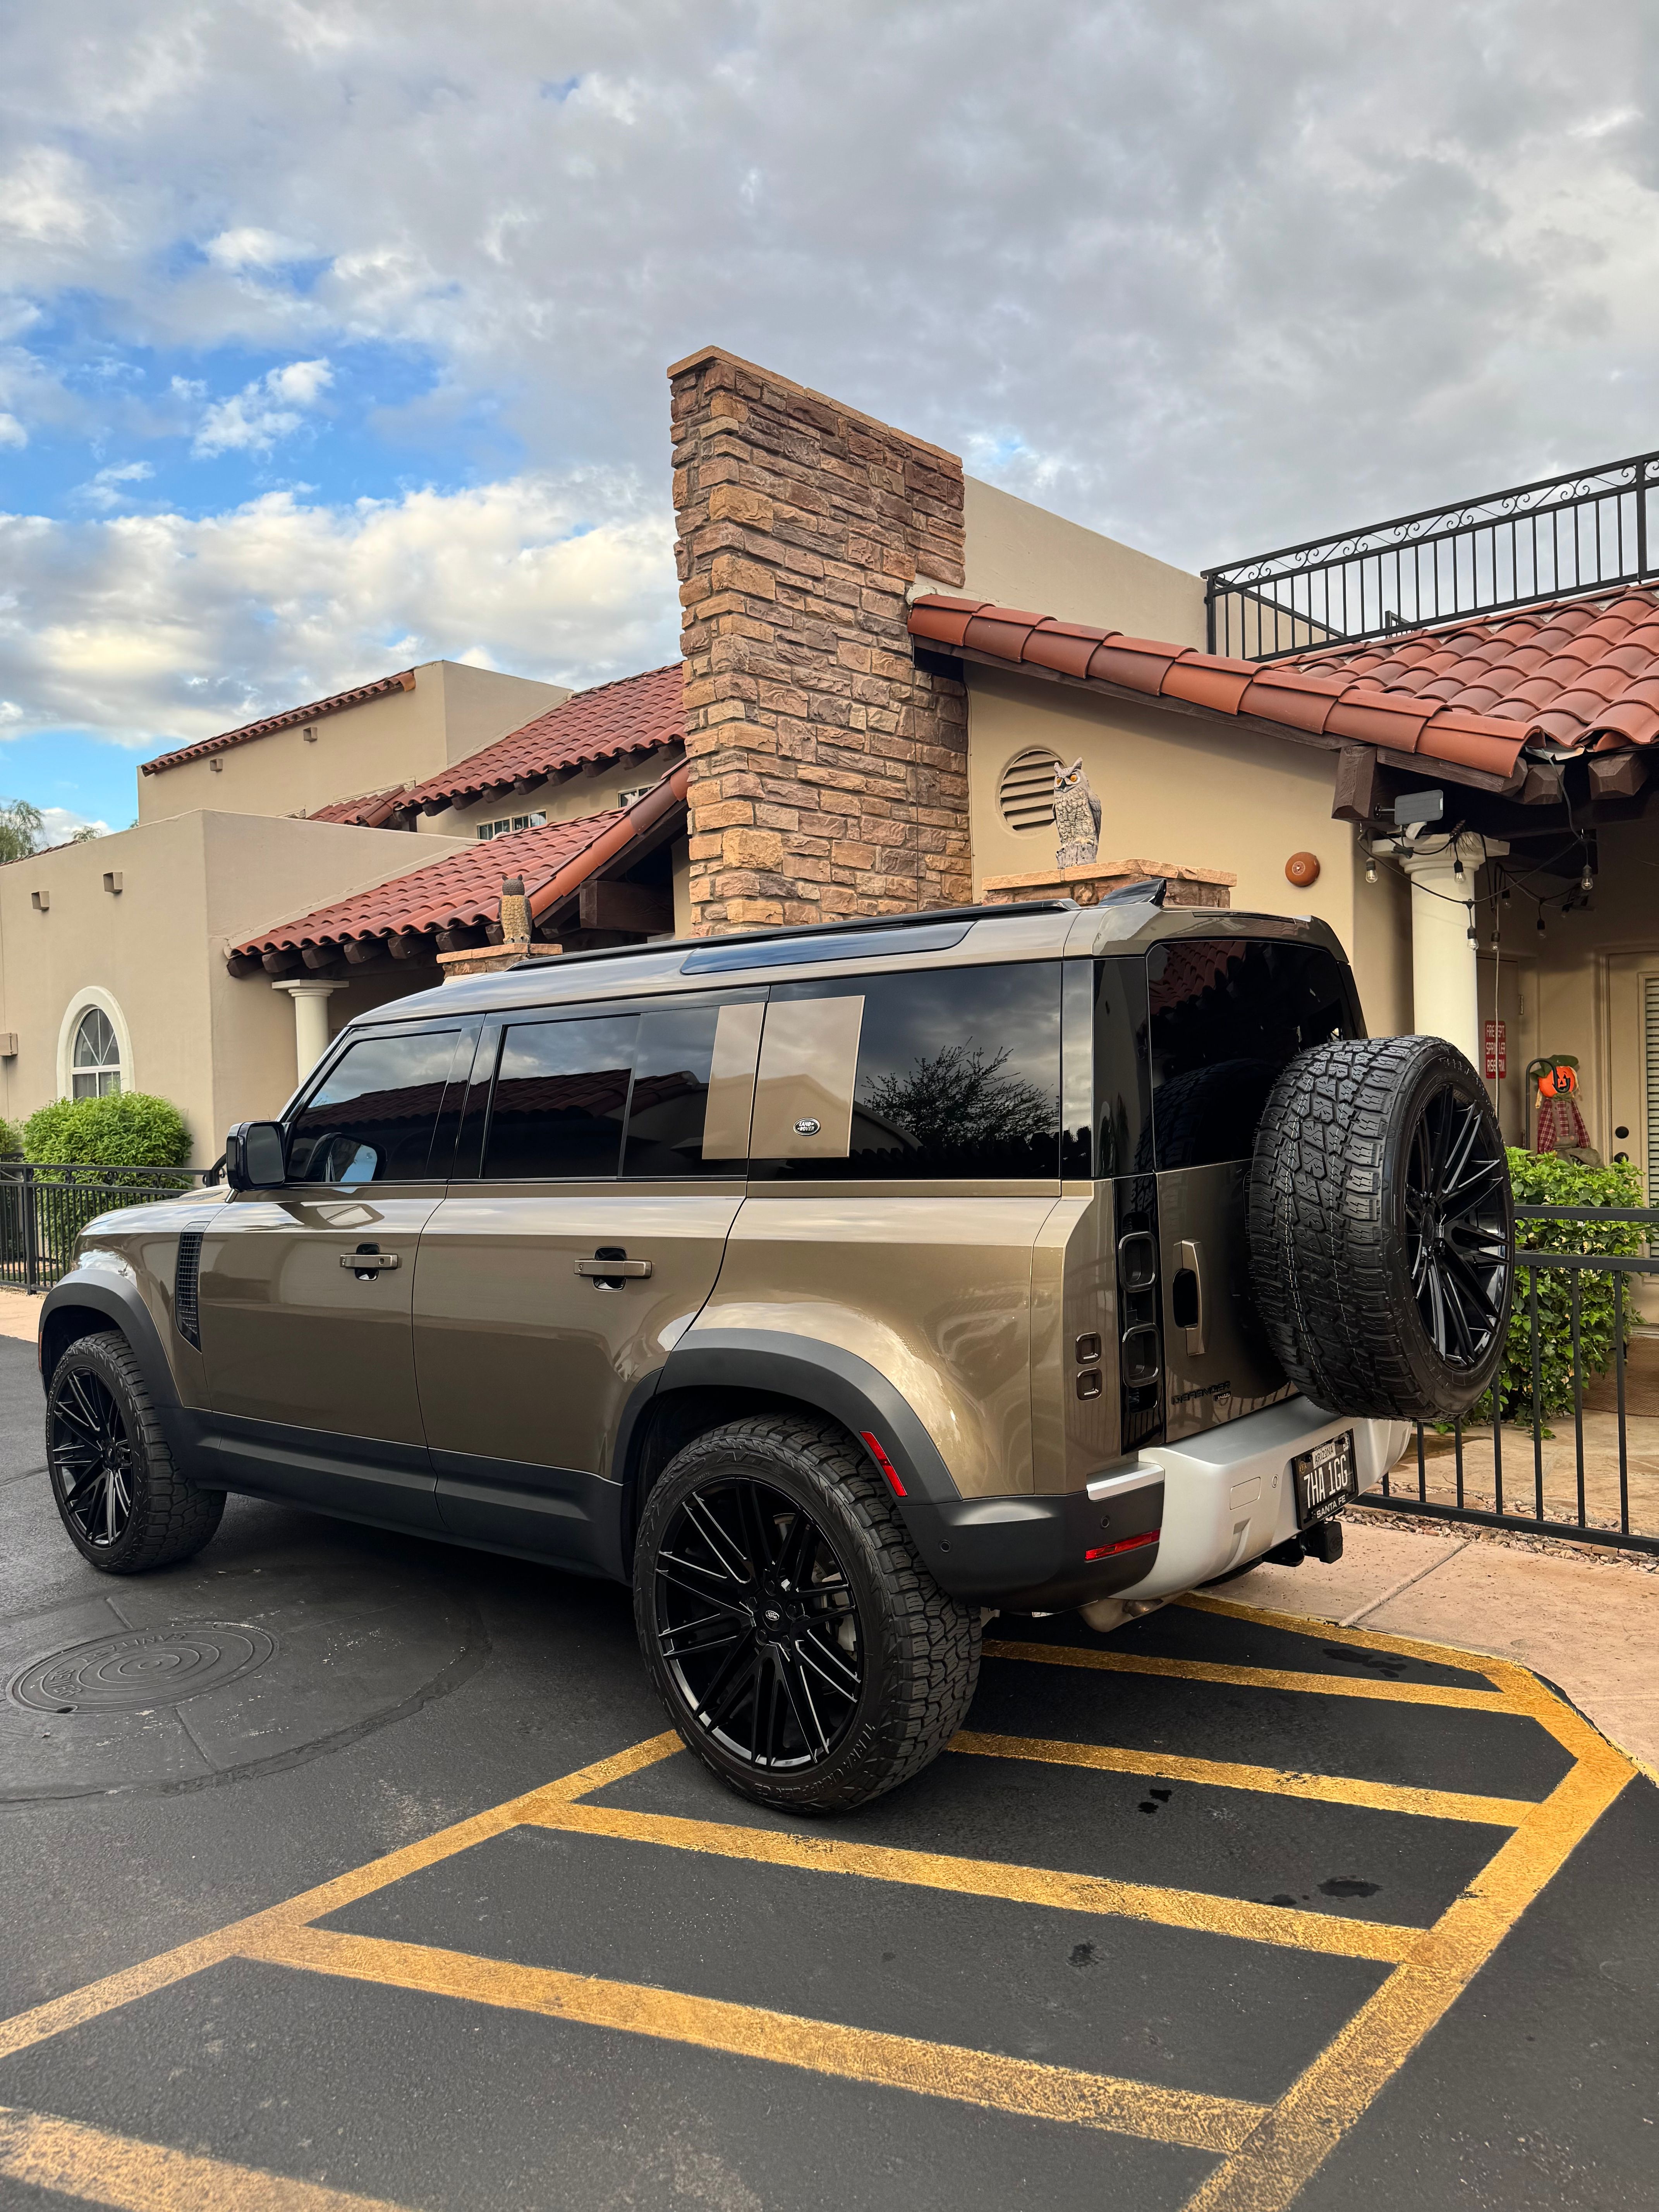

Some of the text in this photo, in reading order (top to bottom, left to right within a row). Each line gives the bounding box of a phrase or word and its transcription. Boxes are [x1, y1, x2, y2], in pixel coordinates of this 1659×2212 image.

[1486, 1025, 1505, 1037] FIRE EPT.
[1486, 1042, 1505, 1054] SPRILER
[1487, 1059, 1498, 1072] RISE
[1171, 1380, 1230, 1405] DEFENDER
[1315, 1446, 1333, 1464] ARIZONA
[1304, 1454, 1348, 1508] 7HA 1GG
[1317, 1494, 1346, 1518] SANTA FE
[49, 1669, 82, 1697] SEWER
